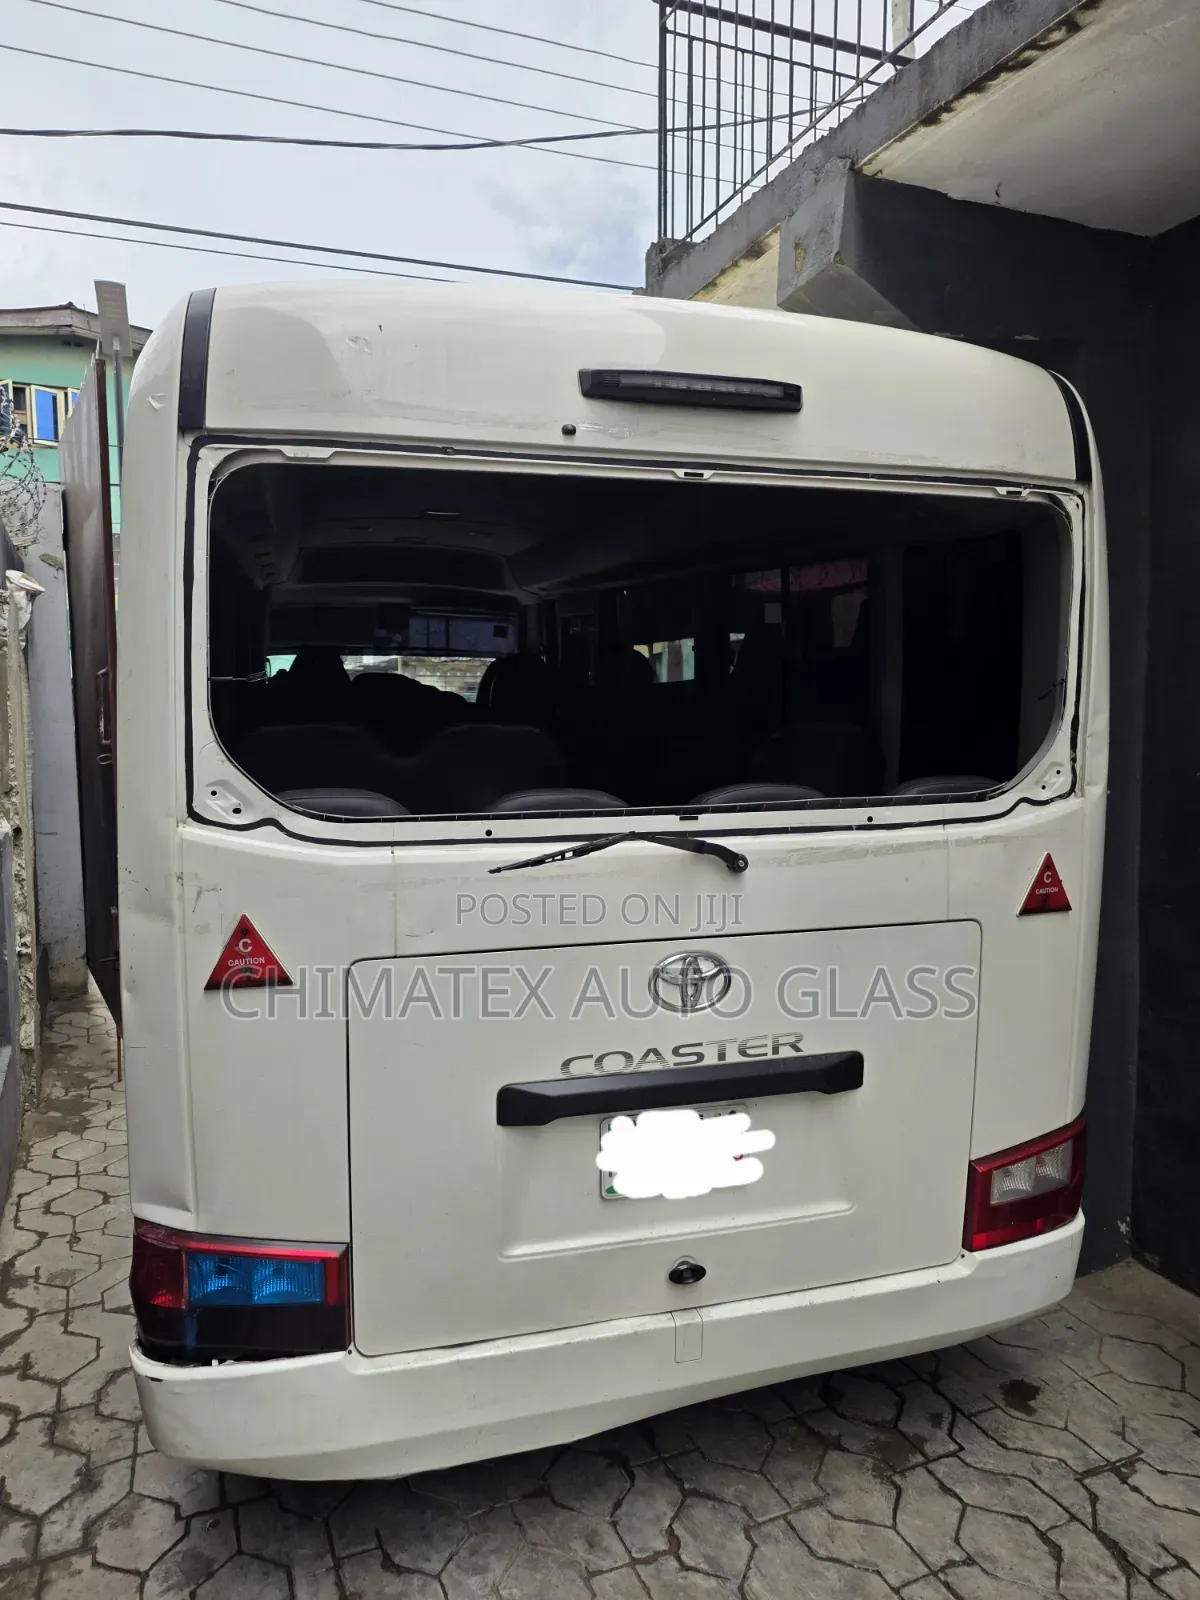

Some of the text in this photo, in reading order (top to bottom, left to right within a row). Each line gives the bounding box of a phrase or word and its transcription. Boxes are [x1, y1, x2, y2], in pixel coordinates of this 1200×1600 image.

[1043, 871, 1052, 883] C
[1035, 886, 1059, 895] CAUTION
[238, 938, 253, 953] C
[227, 956, 265, 967] CAUTION
[560, 1031, 805, 1078] COASTER
